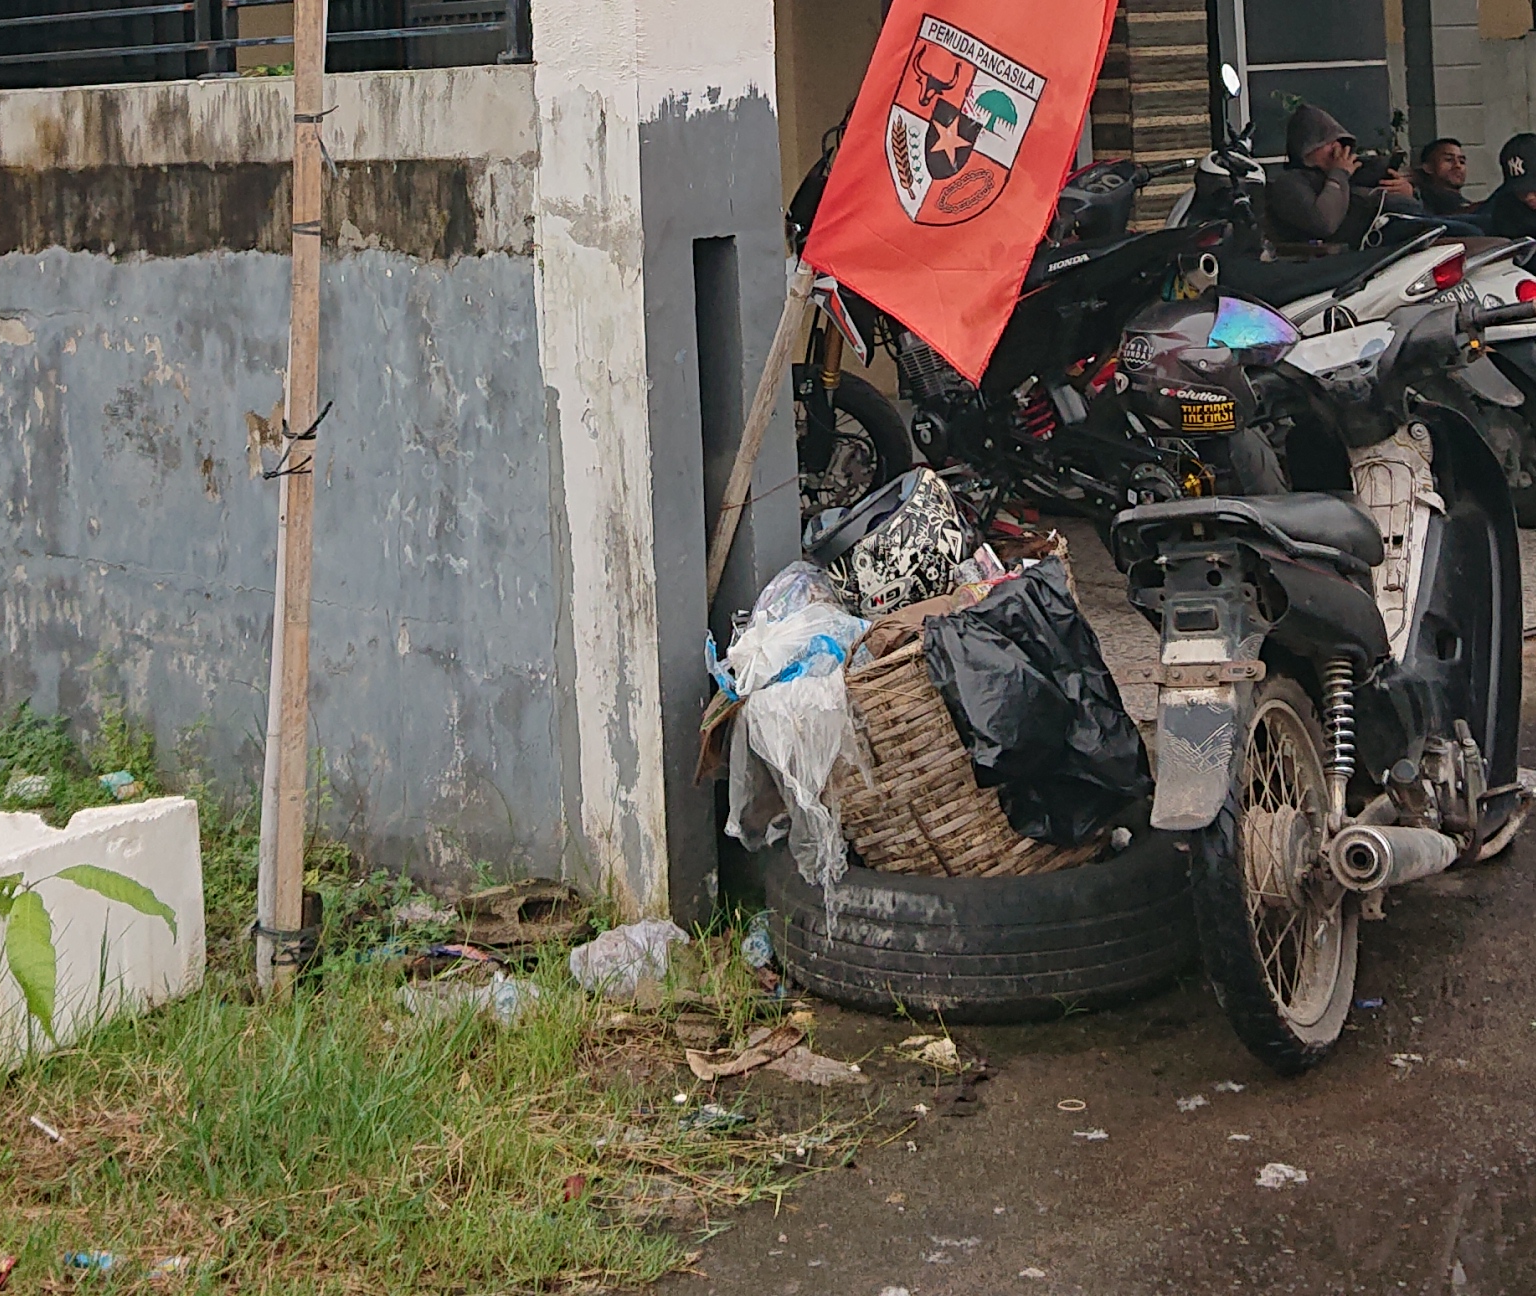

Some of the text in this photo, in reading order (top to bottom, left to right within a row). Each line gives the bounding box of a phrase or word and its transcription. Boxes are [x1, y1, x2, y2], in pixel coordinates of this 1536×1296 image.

[927, 22, 1036, 95] PEMUDA PANCASILA
[1047, 253, 1091, 272] HONDA
[1181, 402, 1235, 423] THE FIRST
[870, 586, 901, 608] GM
